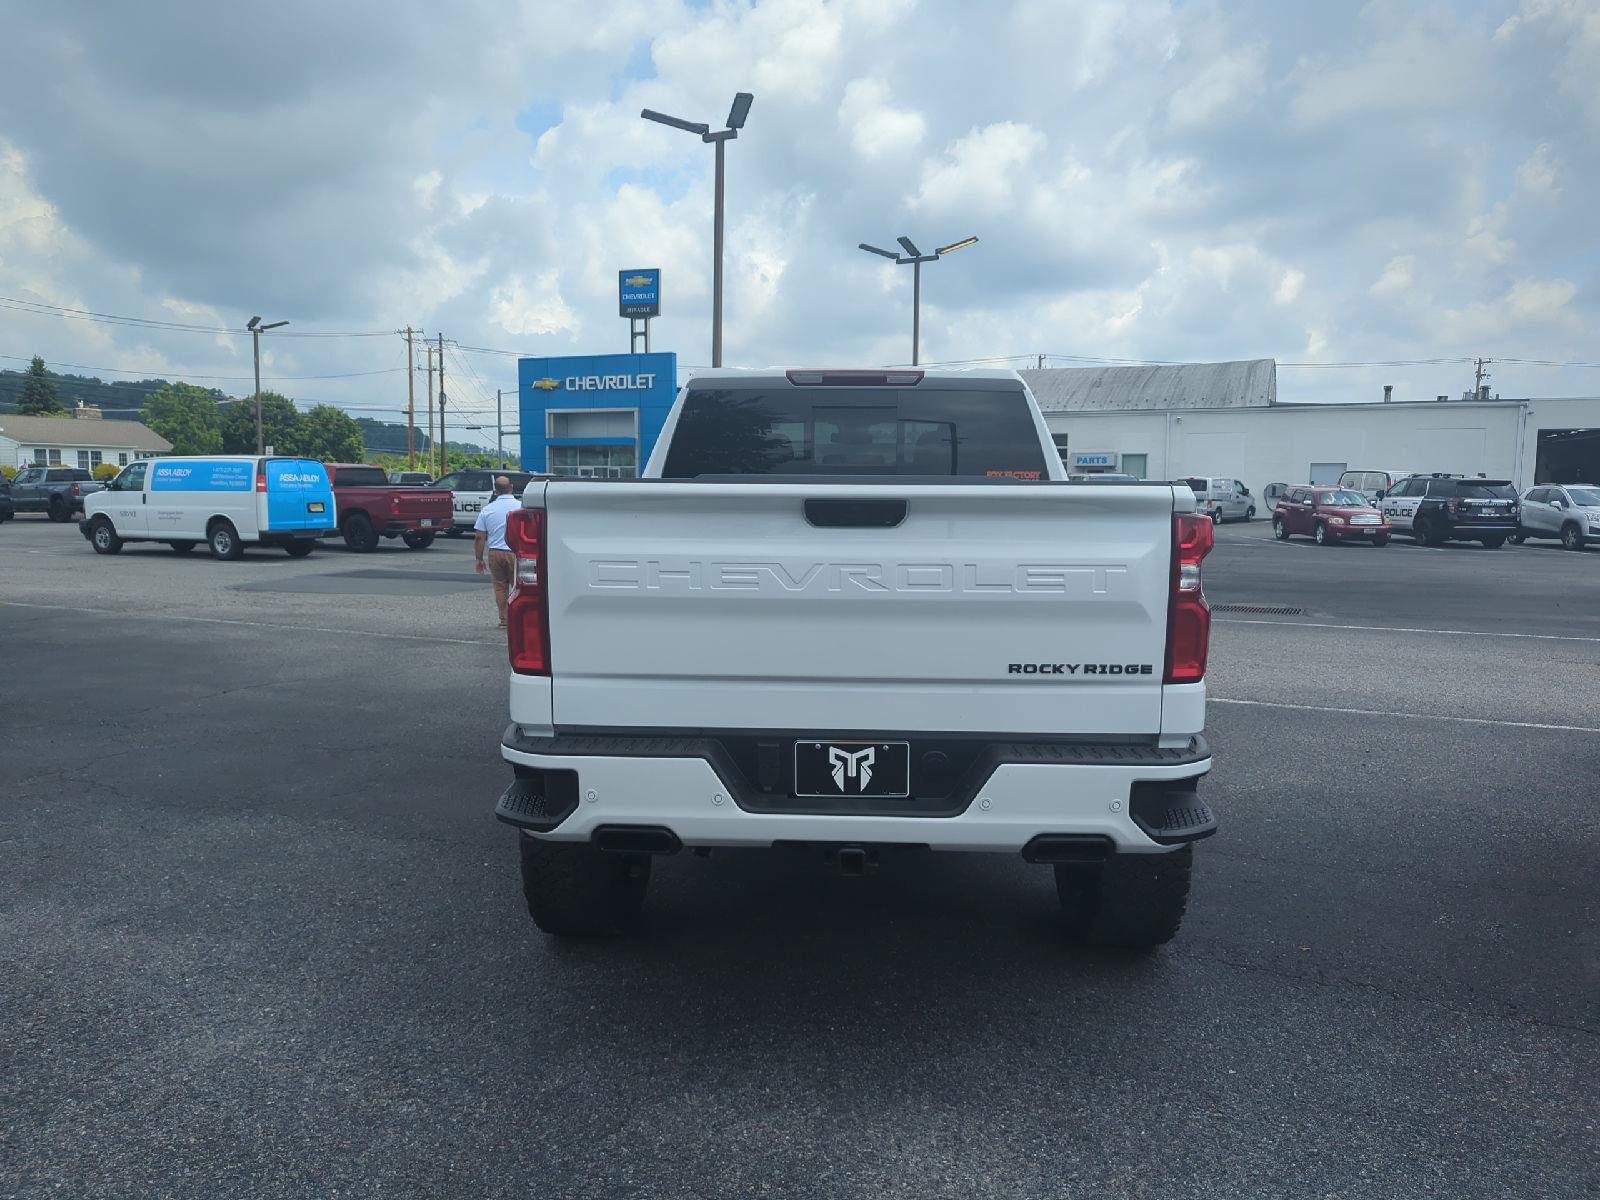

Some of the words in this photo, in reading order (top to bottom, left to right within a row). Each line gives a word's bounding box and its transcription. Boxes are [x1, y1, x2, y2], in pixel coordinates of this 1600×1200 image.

[565, 374, 655, 391] CHEVROLET
[1076, 455, 1107, 464] PARTS
[157, 468, 172, 477] ASSA
[453, 503, 481, 513] LICE
[1384, 508, 1412, 518] POLICE
[588, 560, 1128, 594] CHEVROLET
[1008, 663, 1081, 675] ROCKY
[1083, 663, 1153, 675] RIDGE
